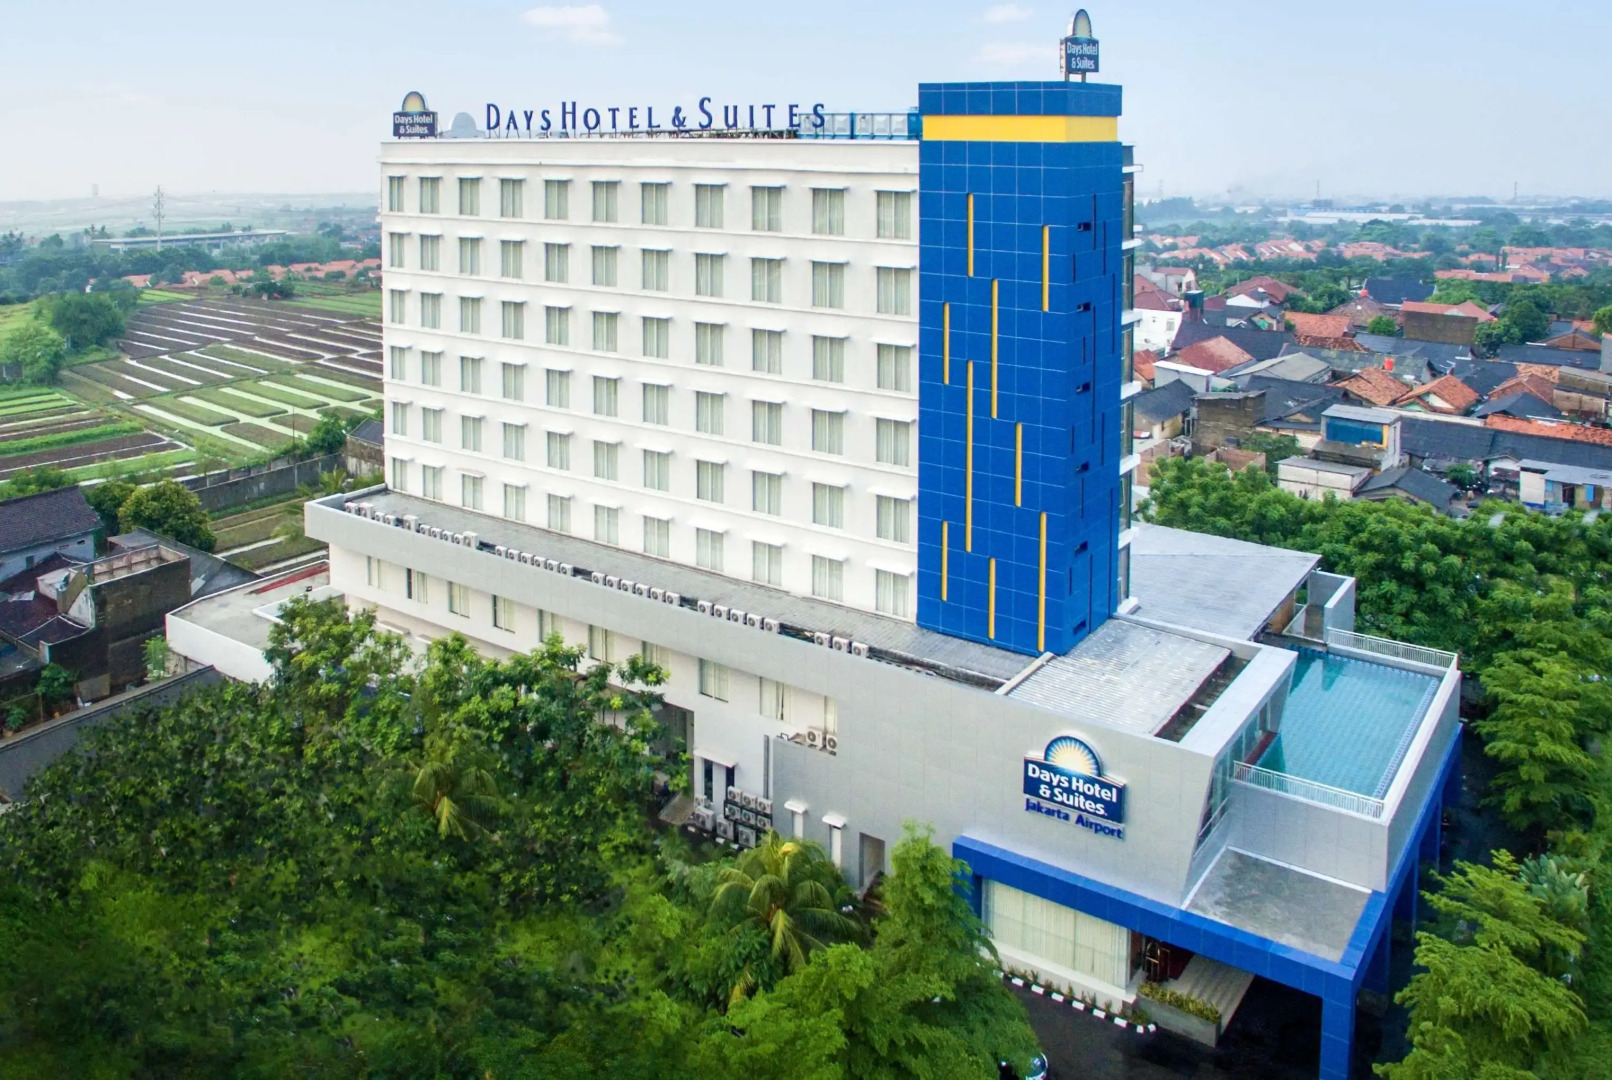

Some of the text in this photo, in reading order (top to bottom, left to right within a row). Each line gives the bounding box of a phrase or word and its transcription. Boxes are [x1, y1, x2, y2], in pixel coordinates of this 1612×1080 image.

[1067, 42, 1097, 55] Days Hotel
[1076, 57, 1094, 69] Suites
[394, 114, 433, 125] Days Hotel
[486, 96, 825, 131] DAYS HOTEL & SUITES
[405, 124, 428, 134] Suites
[1027, 763, 1117, 803] Days Hotel
[1039, 784, 1106, 815] & Suites
[1025, 798, 1123, 839] Jakarta Airport
